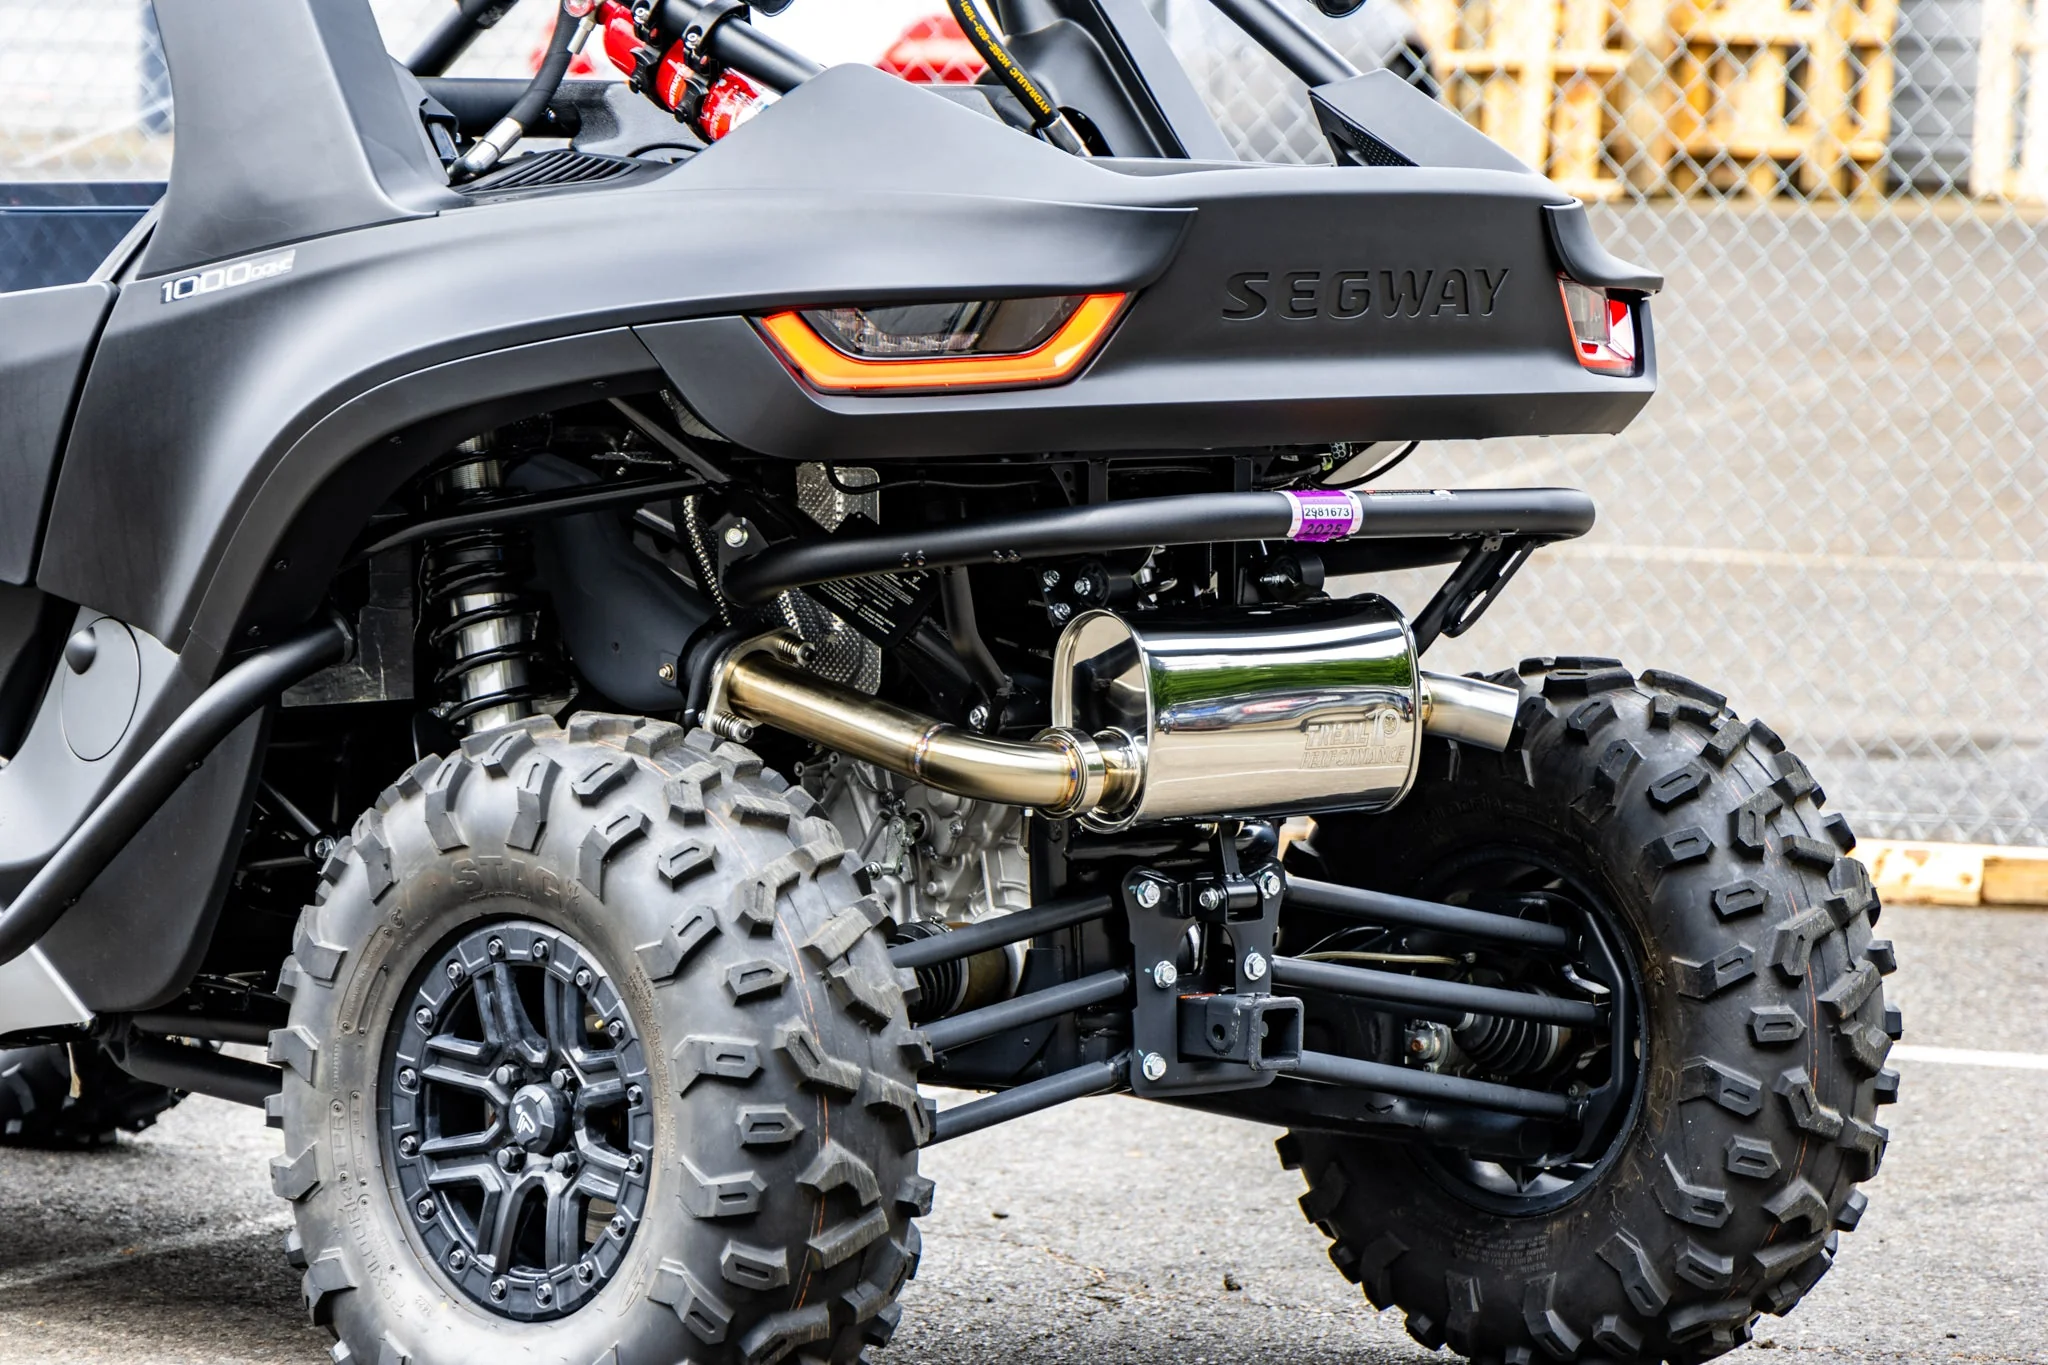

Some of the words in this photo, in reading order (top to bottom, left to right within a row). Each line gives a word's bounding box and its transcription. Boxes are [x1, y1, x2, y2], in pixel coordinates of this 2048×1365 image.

[1009, 67, 1051, 114] HYDRAULIC
[161, 262, 251, 302] 1000
[1221, 269, 1509, 321] SEGWAY
[1305, 507, 1350, 518] 2981673
[1305, 523, 1342, 536] 2025
